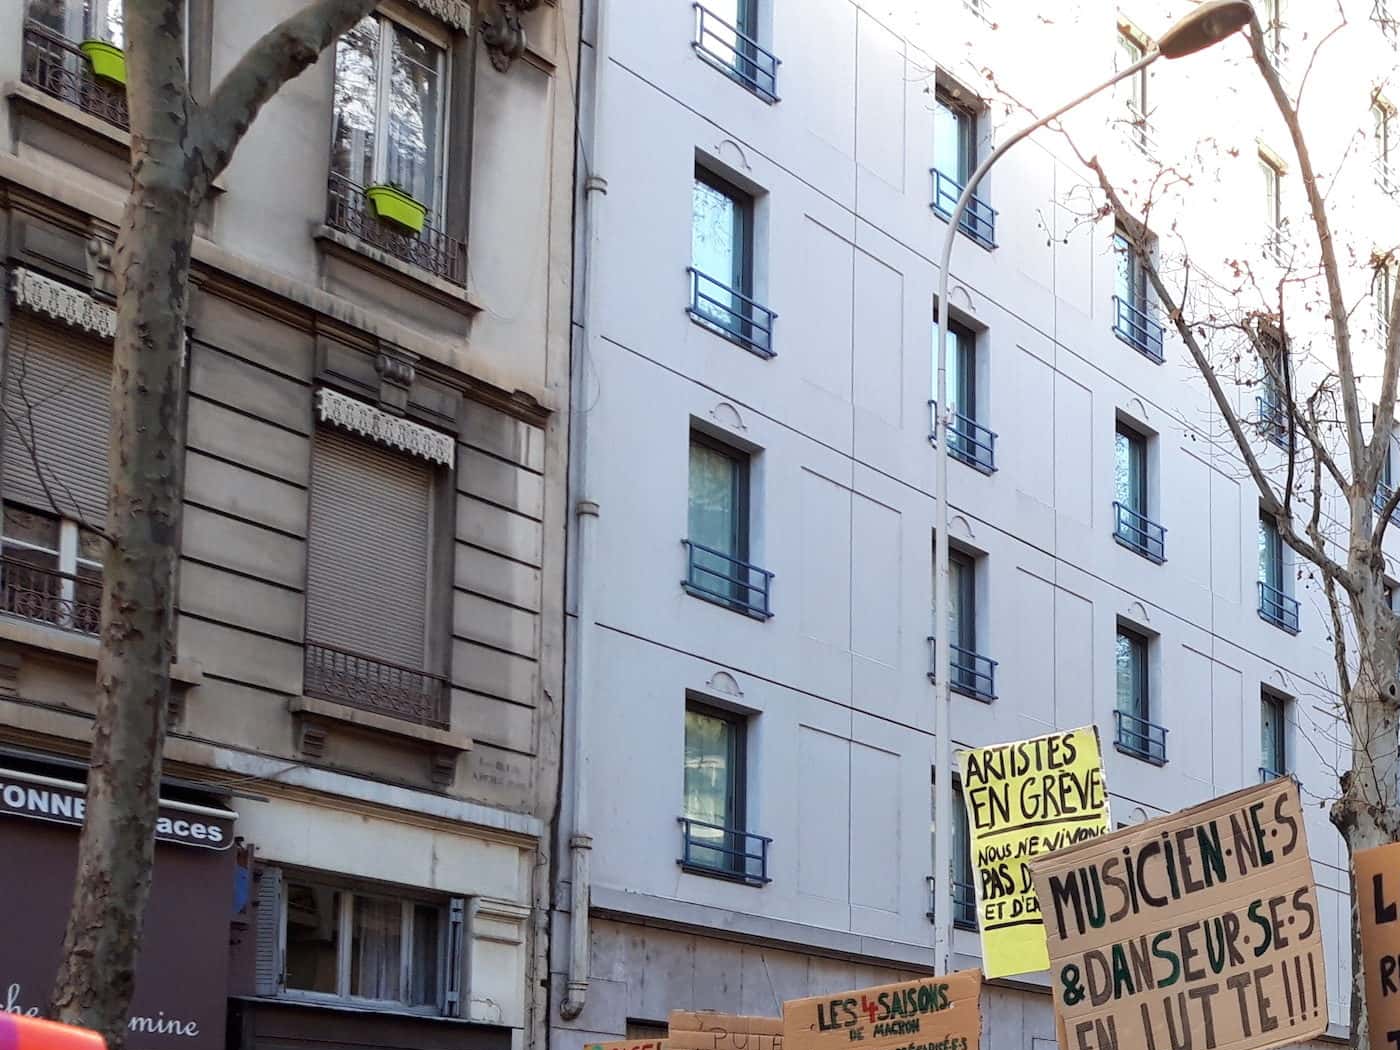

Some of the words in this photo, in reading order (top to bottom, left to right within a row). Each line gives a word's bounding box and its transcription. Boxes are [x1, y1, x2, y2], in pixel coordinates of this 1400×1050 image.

[965, 733, 1077, 787] ARTISTES
[0, 785, 86, 819] ONNE
[969, 783, 1010, 829] EN
[978, 843, 1012, 868] NOUS
[1014, 836, 1039, 858] NE
[980, 863, 1015, 900] PAS
[985, 902, 1006, 920] ET
[817, 998, 858, 1031] LES
[862, 995, 878, 1023] 4
[849, 1026, 864, 1041] DE
[873, 1018, 920, 1038] MACRON
